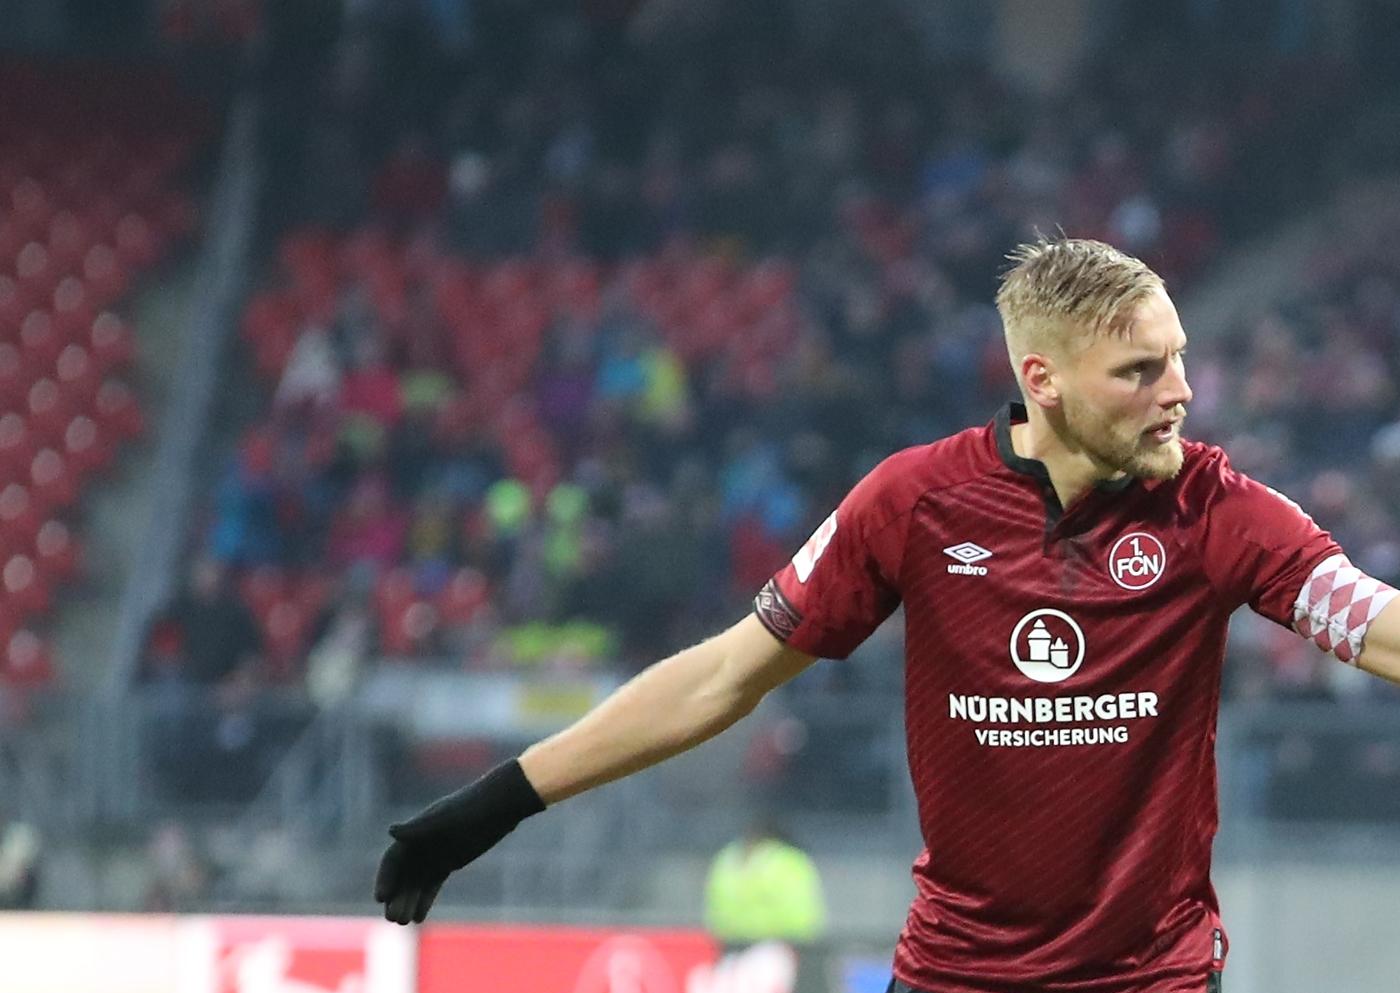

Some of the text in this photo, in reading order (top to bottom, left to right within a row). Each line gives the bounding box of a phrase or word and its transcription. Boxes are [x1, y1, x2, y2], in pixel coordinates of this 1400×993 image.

[947, 563, 988, 576] umbro
[1117, 554, 1159, 578] FCN
[949, 692, 1158, 723] NÜRNBERGER
[975, 726, 1129, 746] VERSICHERUNG
